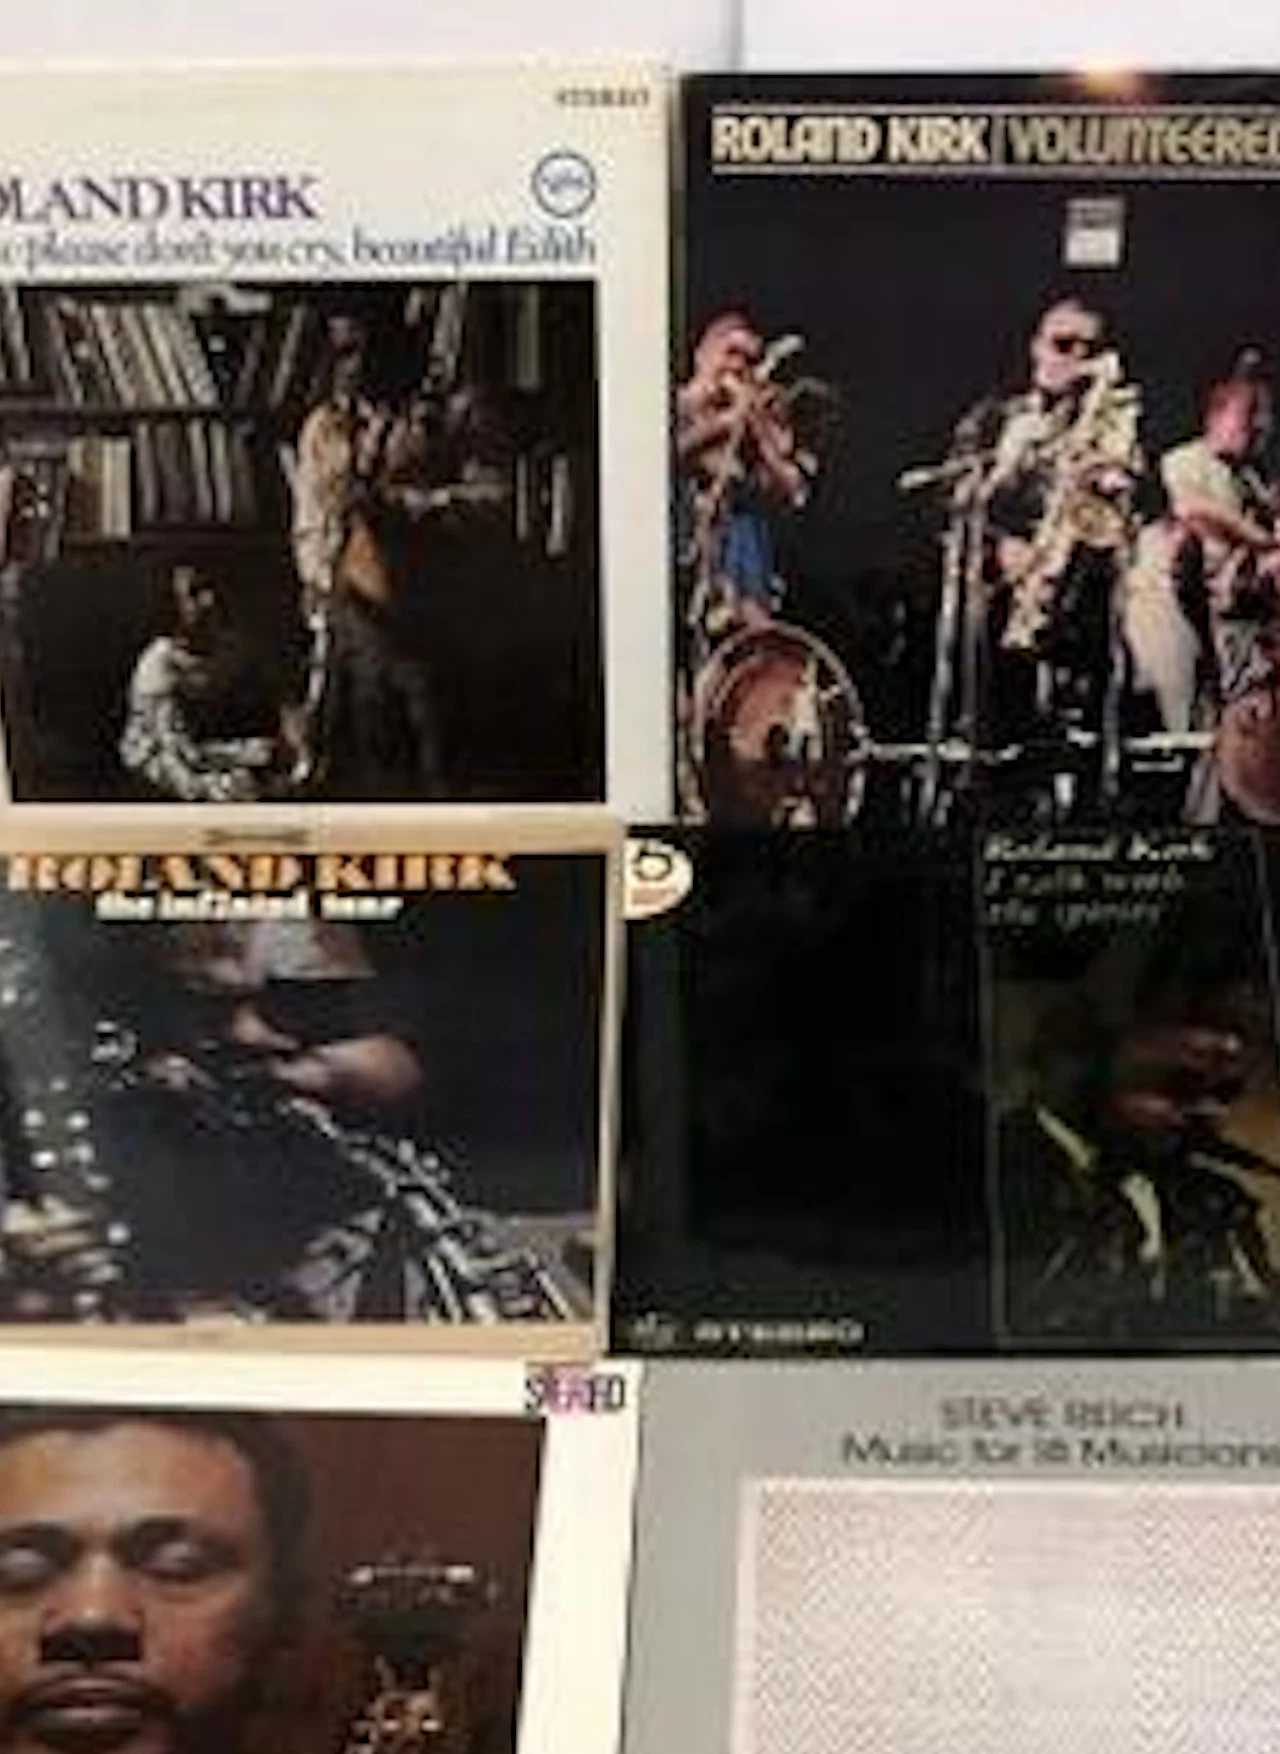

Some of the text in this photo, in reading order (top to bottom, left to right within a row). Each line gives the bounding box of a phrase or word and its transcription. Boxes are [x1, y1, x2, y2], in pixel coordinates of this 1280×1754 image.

[711, 114, 883, 165] ROLAND
[887, 115, 993, 165] KIRK
[175, 175, 320, 221] KIRK
[840, 1431, 962, 1468] Music
[972, 1431, 1023, 1465] for
